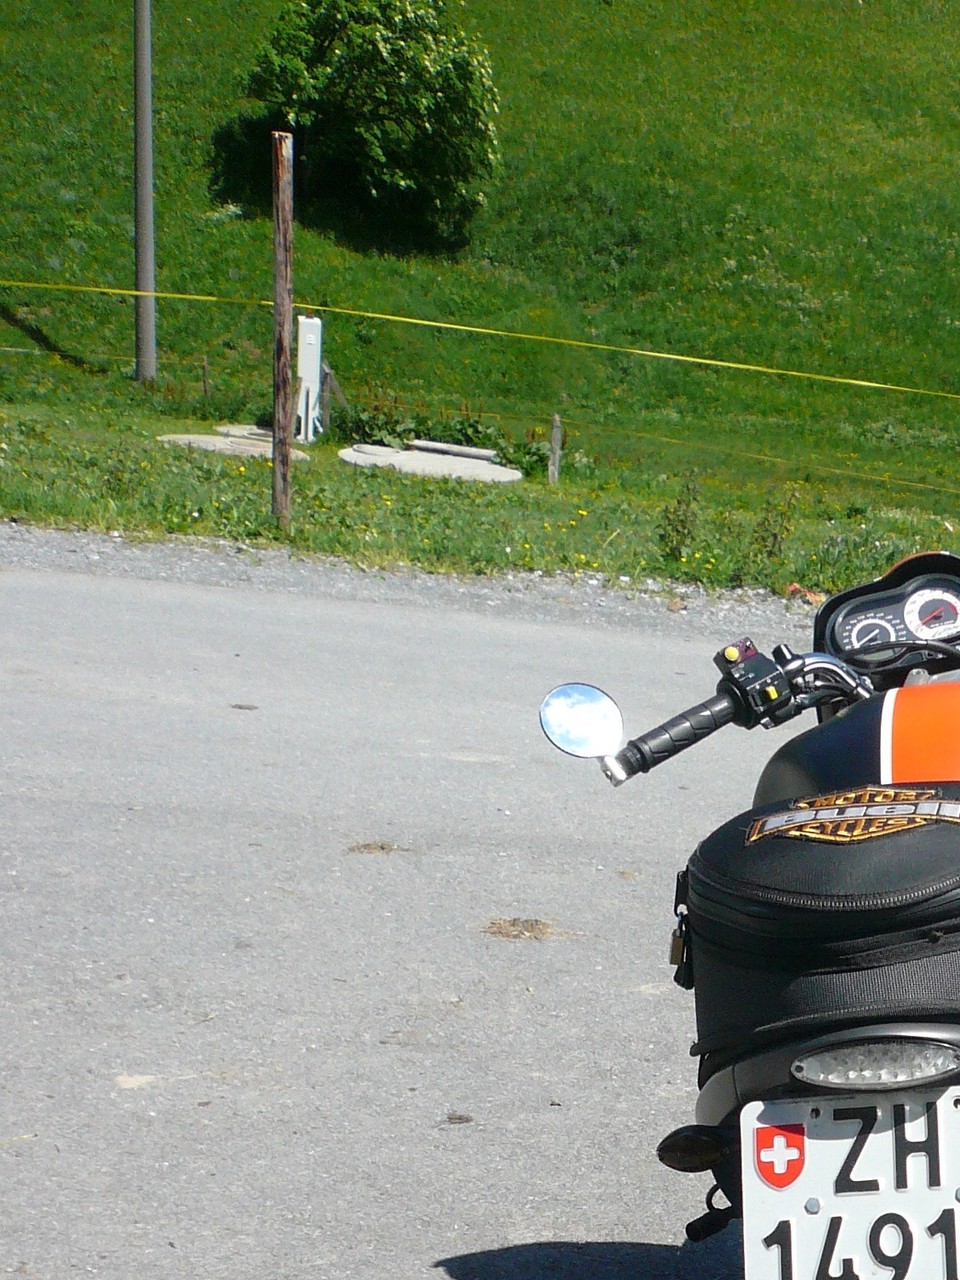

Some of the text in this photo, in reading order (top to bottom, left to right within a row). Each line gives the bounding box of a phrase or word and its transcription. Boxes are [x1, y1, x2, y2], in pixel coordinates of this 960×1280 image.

[813, 789, 917, 807] MOTOR
[801, 818, 909, 837] CYCLES
[833, 1101, 941, 1194] ZH
